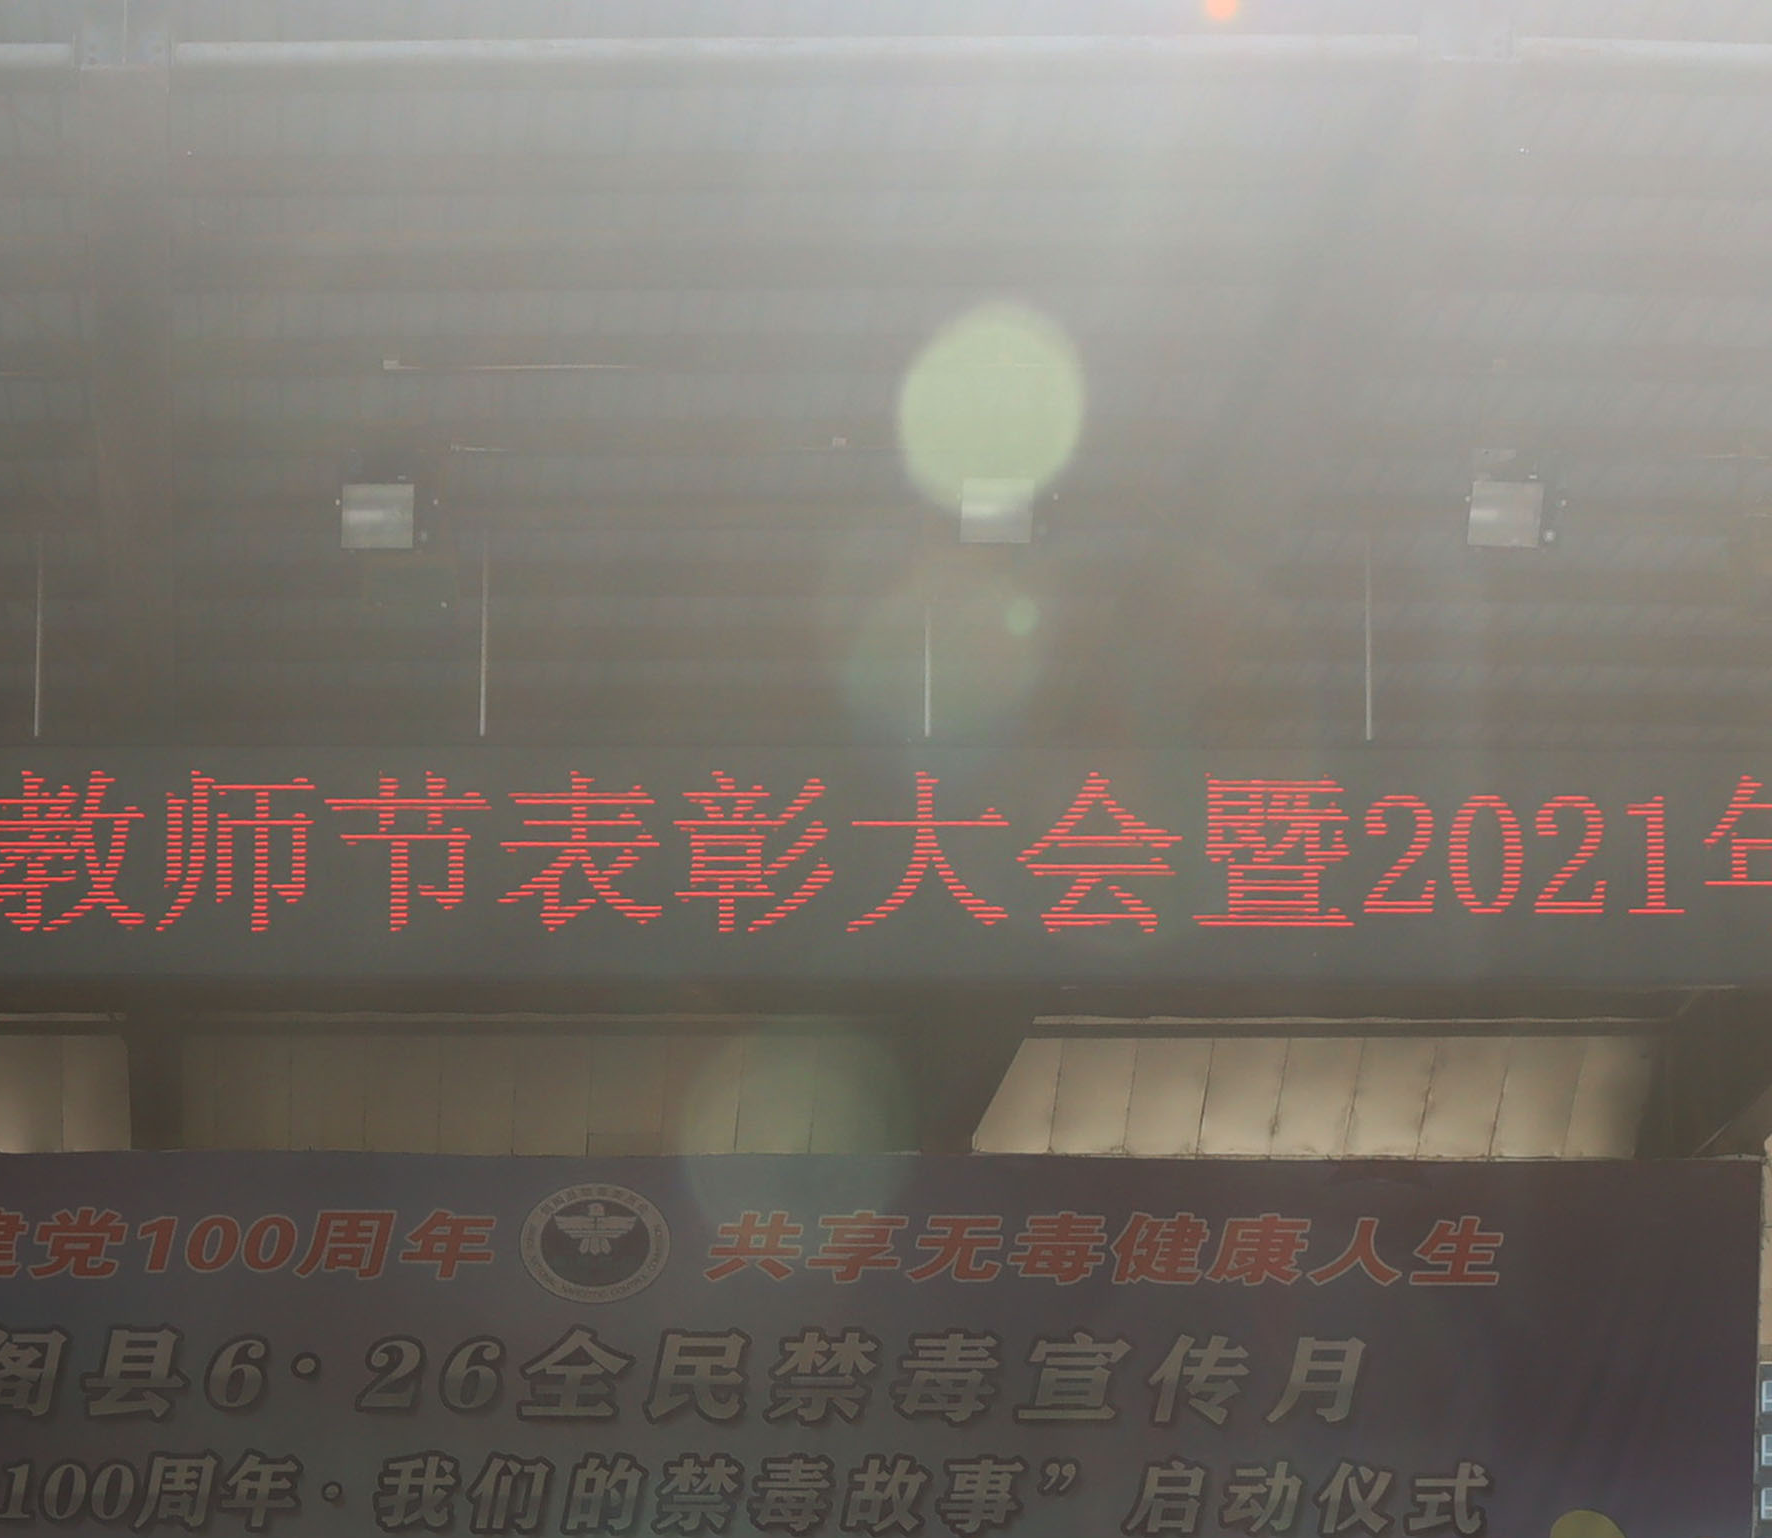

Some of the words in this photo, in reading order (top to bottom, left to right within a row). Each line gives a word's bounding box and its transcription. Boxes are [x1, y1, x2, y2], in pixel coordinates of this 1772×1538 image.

[704, 1210, 1505, 1286] 共享无毒健康人生
